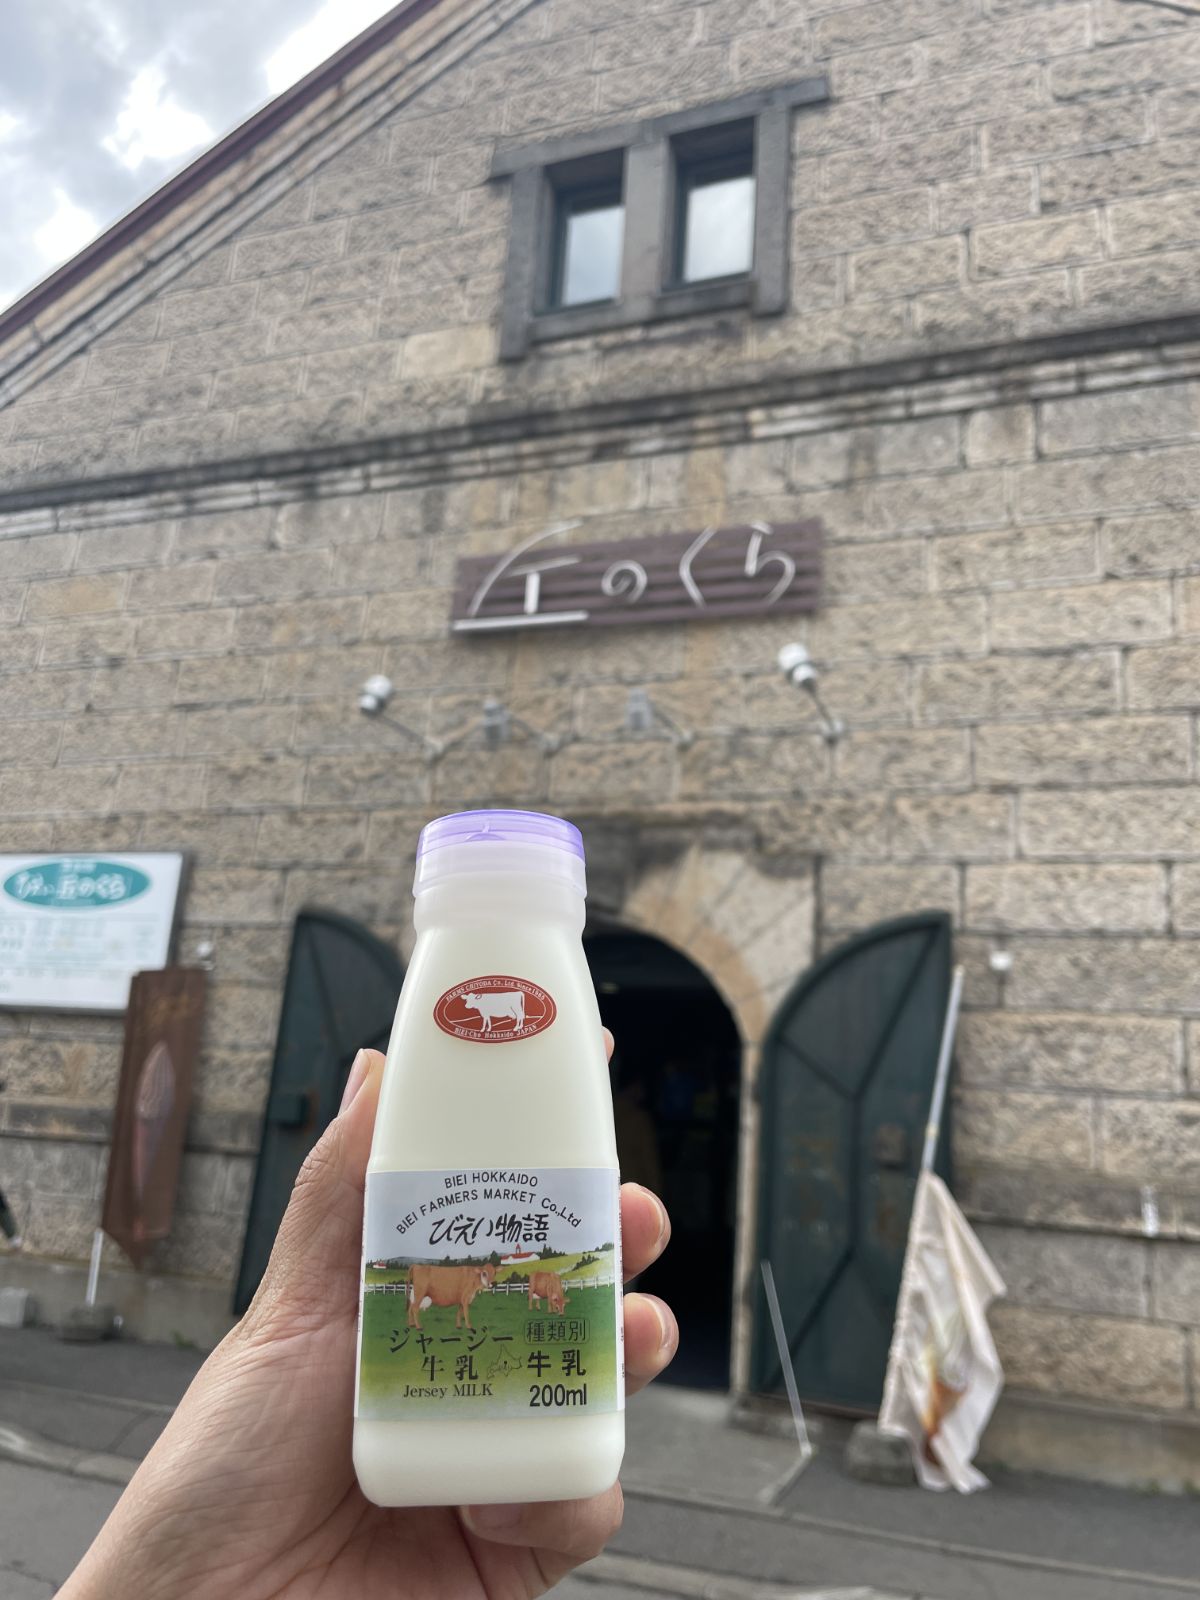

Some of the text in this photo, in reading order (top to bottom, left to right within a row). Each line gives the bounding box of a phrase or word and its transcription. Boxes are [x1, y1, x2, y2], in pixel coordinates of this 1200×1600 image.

[444, 1171, 539, 1189] BIEI HOKKAIDO
[396, 1212, 419, 1235] BIEI
[420, 1189, 479, 1217] FARMERS
[483, 1188, 537, 1205] MARKET
[428, 1213, 551, 1246] びえい物語
[389, 1325, 514, 1354] ジャージー
[526, 1319, 588, 1343] 種類別
[421, 1354, 480, 1382] 牛乳
[527, 1348, 587, 1378] 牛乳
[403, 1383, 494, 1400] Jersey MILK
[529, 1383, 588, 1408] 200ml
